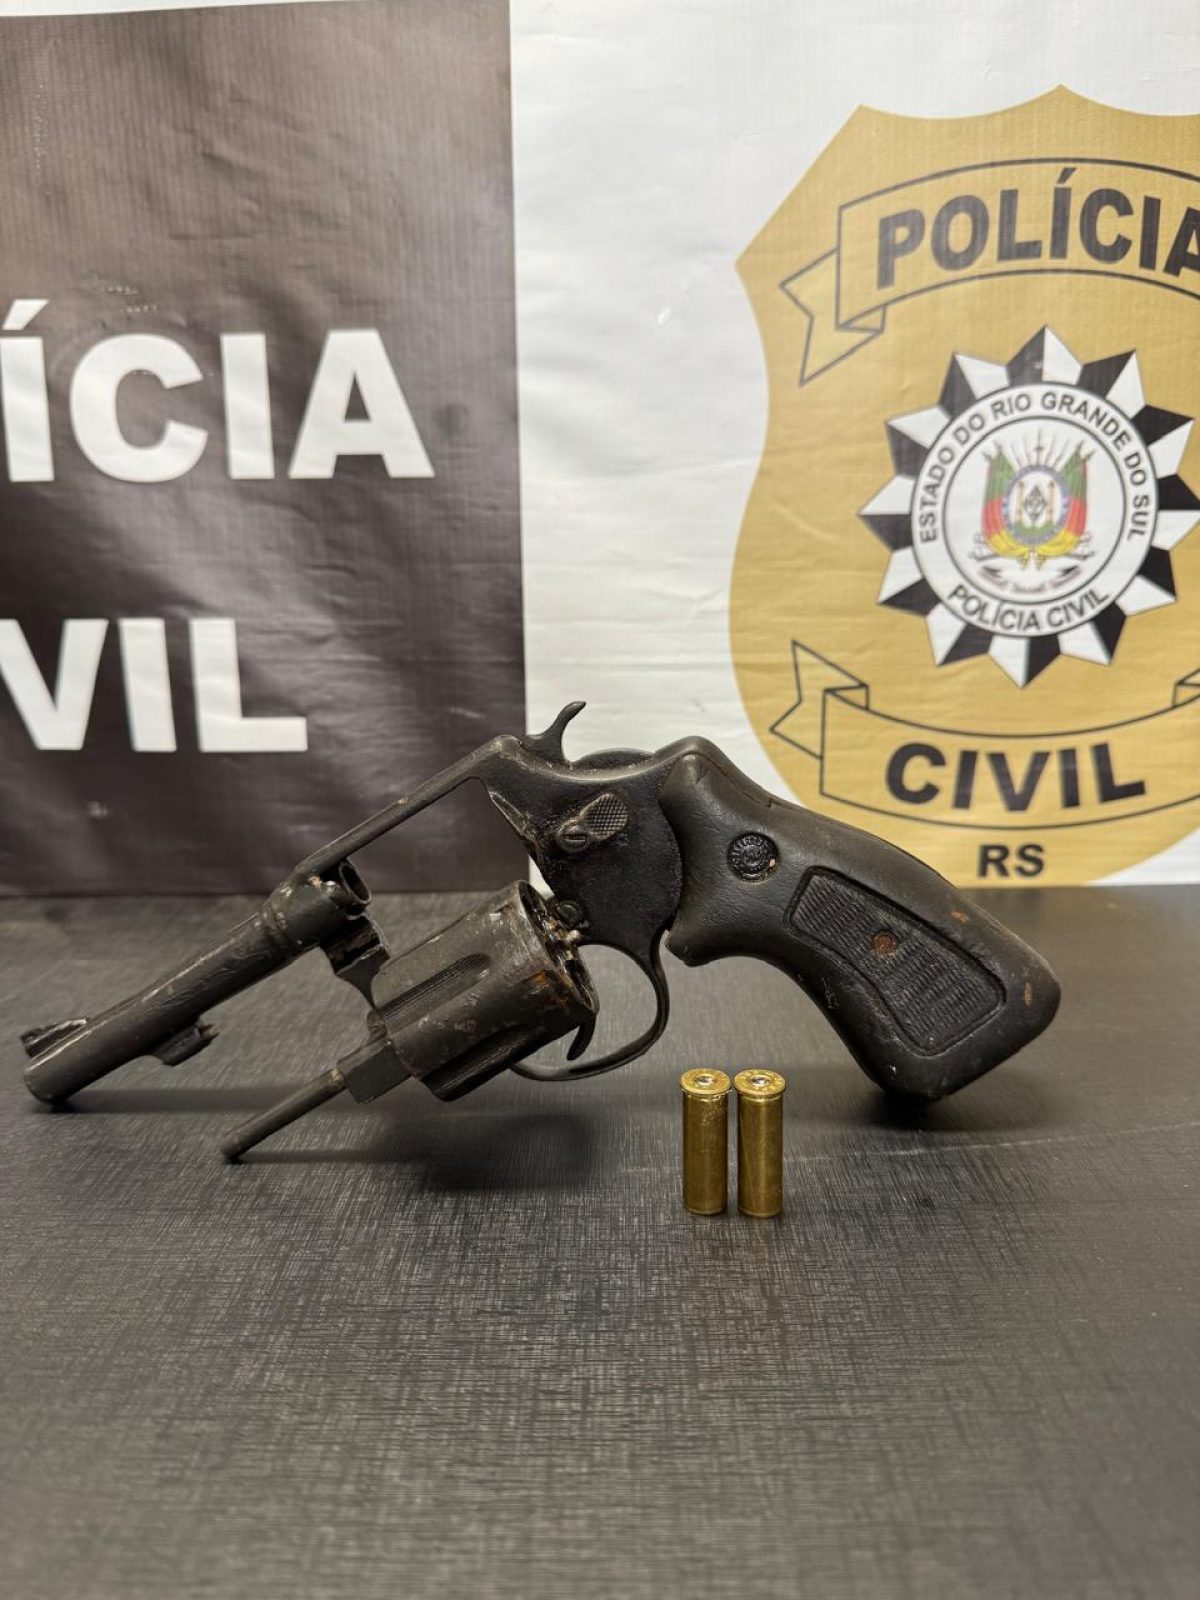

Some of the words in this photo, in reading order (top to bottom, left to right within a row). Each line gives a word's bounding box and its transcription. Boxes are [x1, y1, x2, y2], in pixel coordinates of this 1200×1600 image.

[877, 167, 1200, 290] POLÍCIA
[990, 393, 1032, 421] RIO
[1040, 391, 1131, 453] GRANDE
[954, 415, 986, 446] DO
[1123, 451, 1147, 488] DO
[919, 449, 955, 543] ESTADO
[1129, 494, 1149, 540] SUL
[949, 584, 1040, 631] POLÍCIA
[1047, 590, 1109, 629] CIVIL
[885, 742, 1146, 812] CIVIL
[977, 843, 1045, 878] RS
